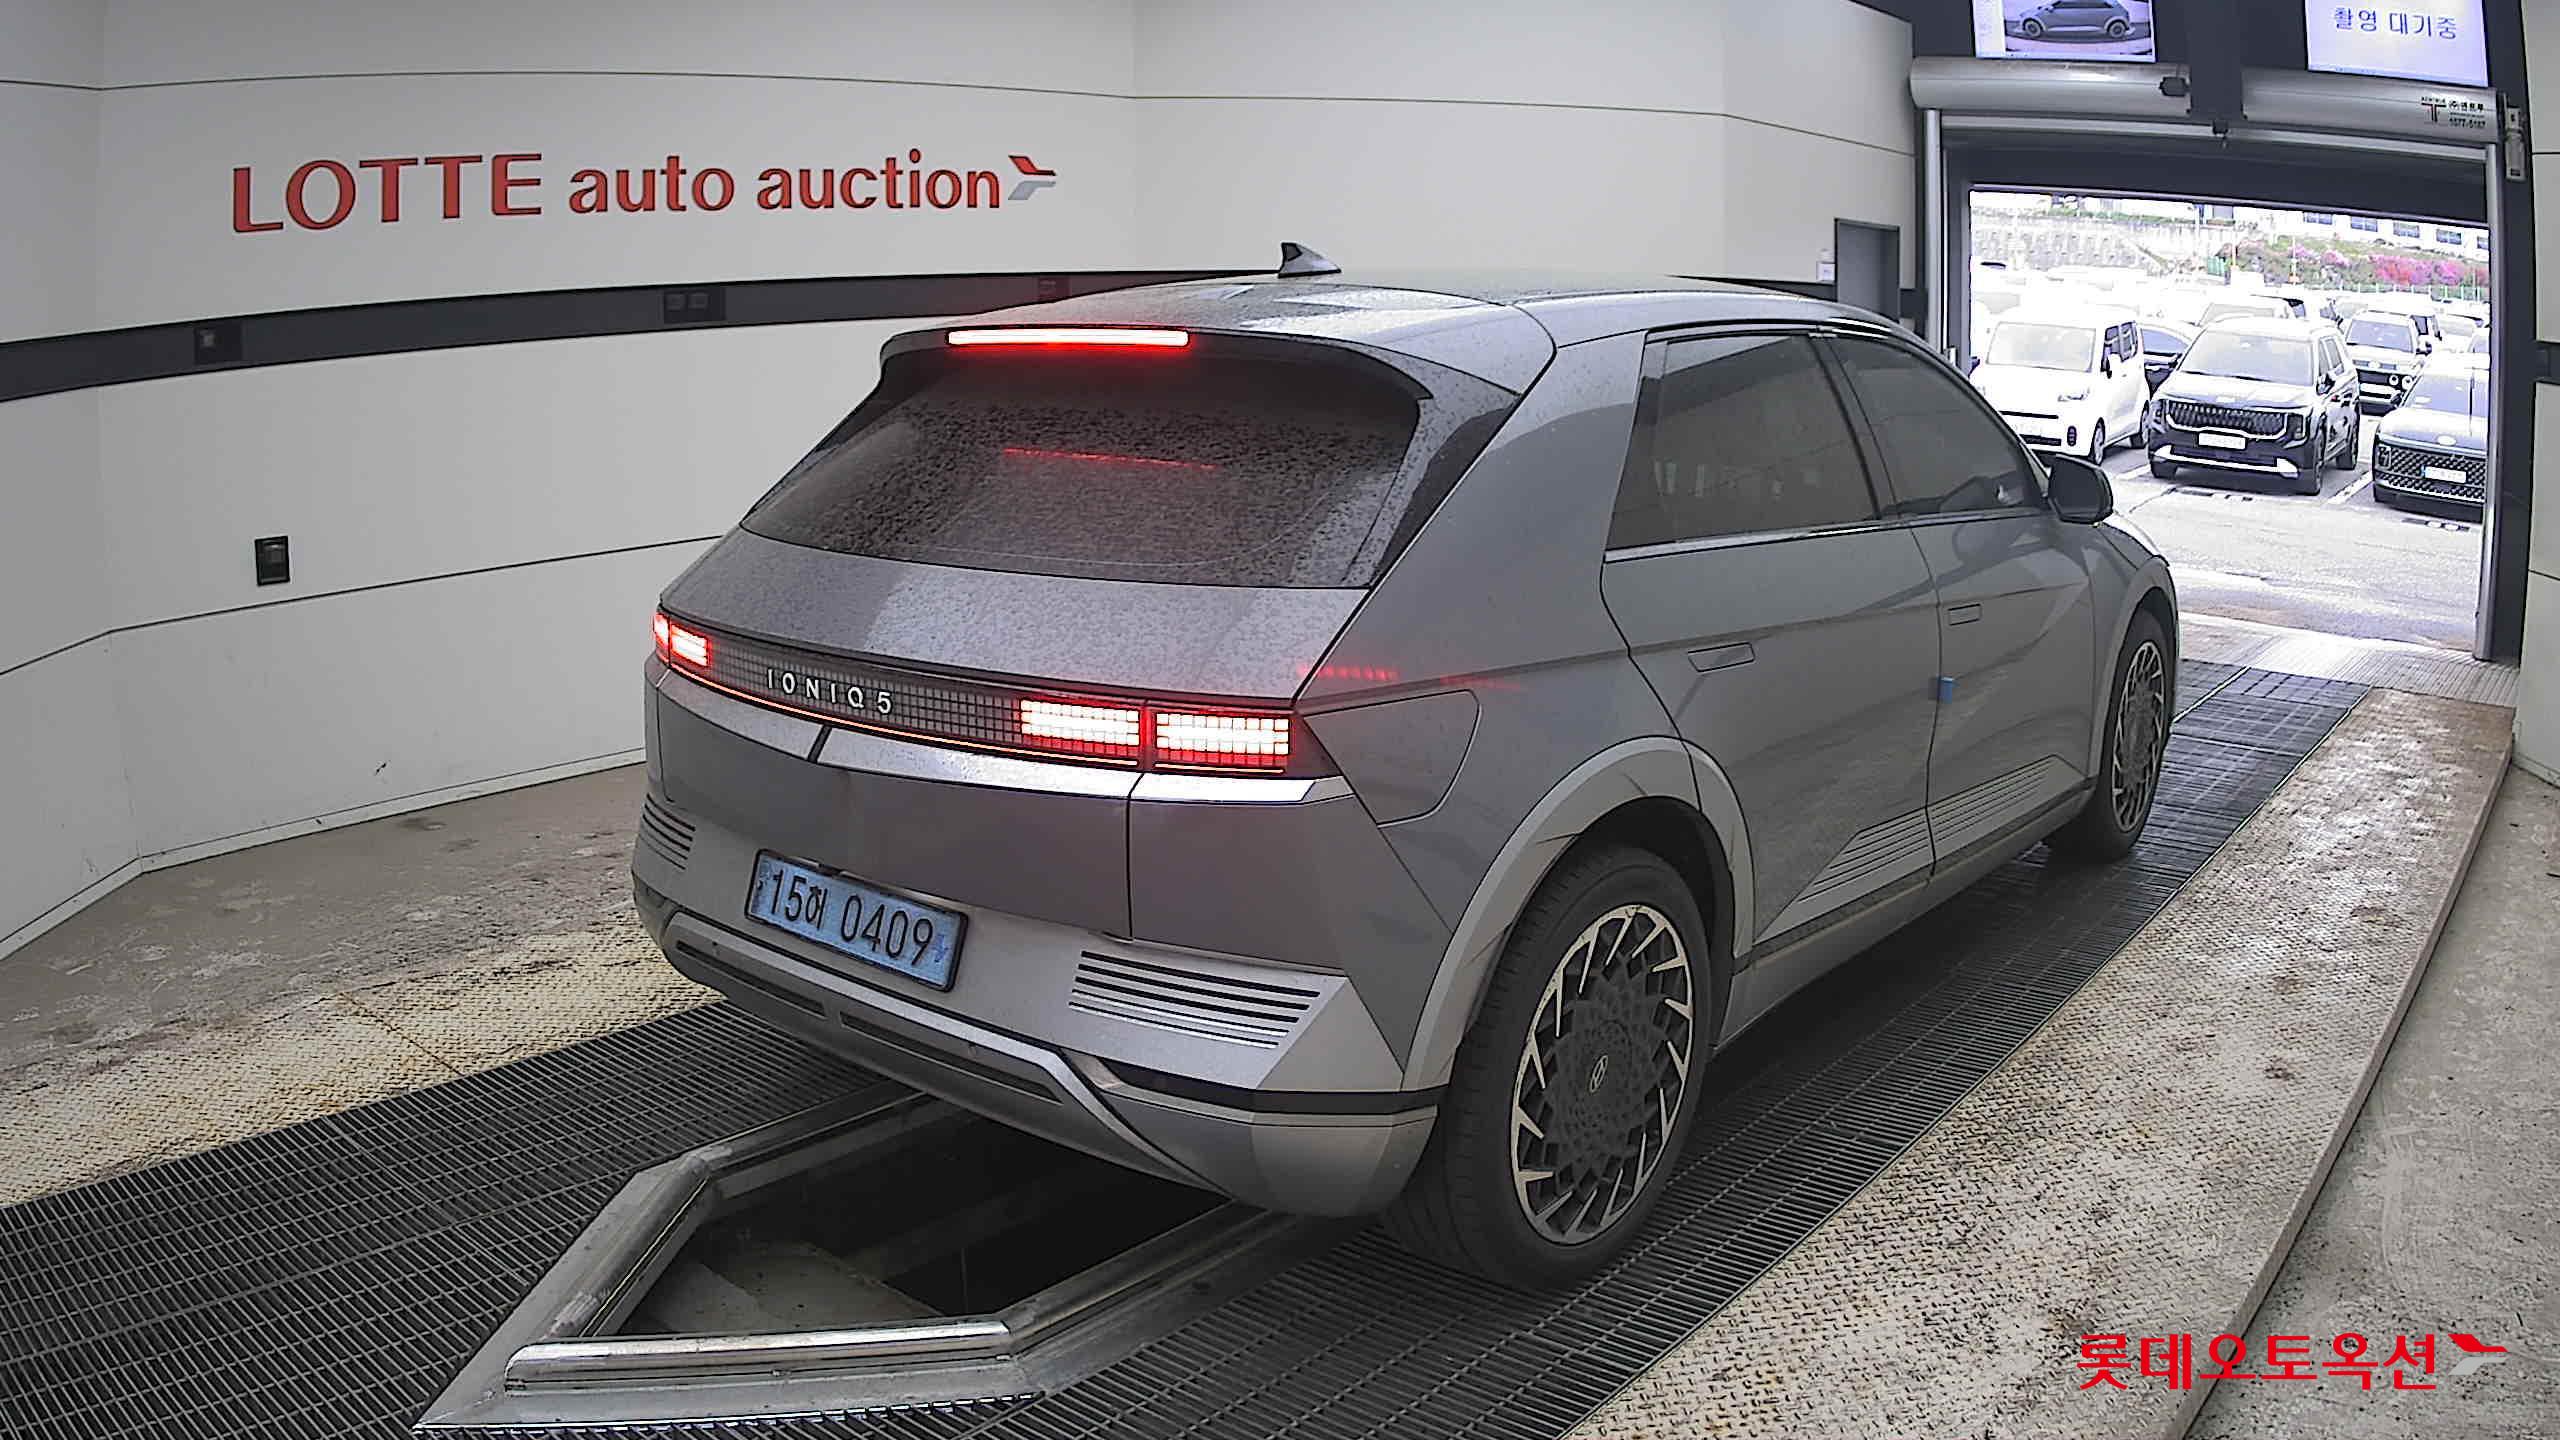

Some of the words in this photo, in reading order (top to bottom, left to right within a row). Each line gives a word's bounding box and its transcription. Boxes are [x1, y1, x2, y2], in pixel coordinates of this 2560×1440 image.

[2334, 7, 2377, 32] 촬영
[2389, 12, 2457, 40] 대기중
[232, 153, 543, 233] LOTTE
[568, 155, 735, 214] auto
[756, 149, 1001, 210] auction
[767, 668, 865, 710] IONIQ
[876, 691, 893, 714] 5
[771, 869, 828, 931] 15허
[840, 894, 934, 966] 0409
